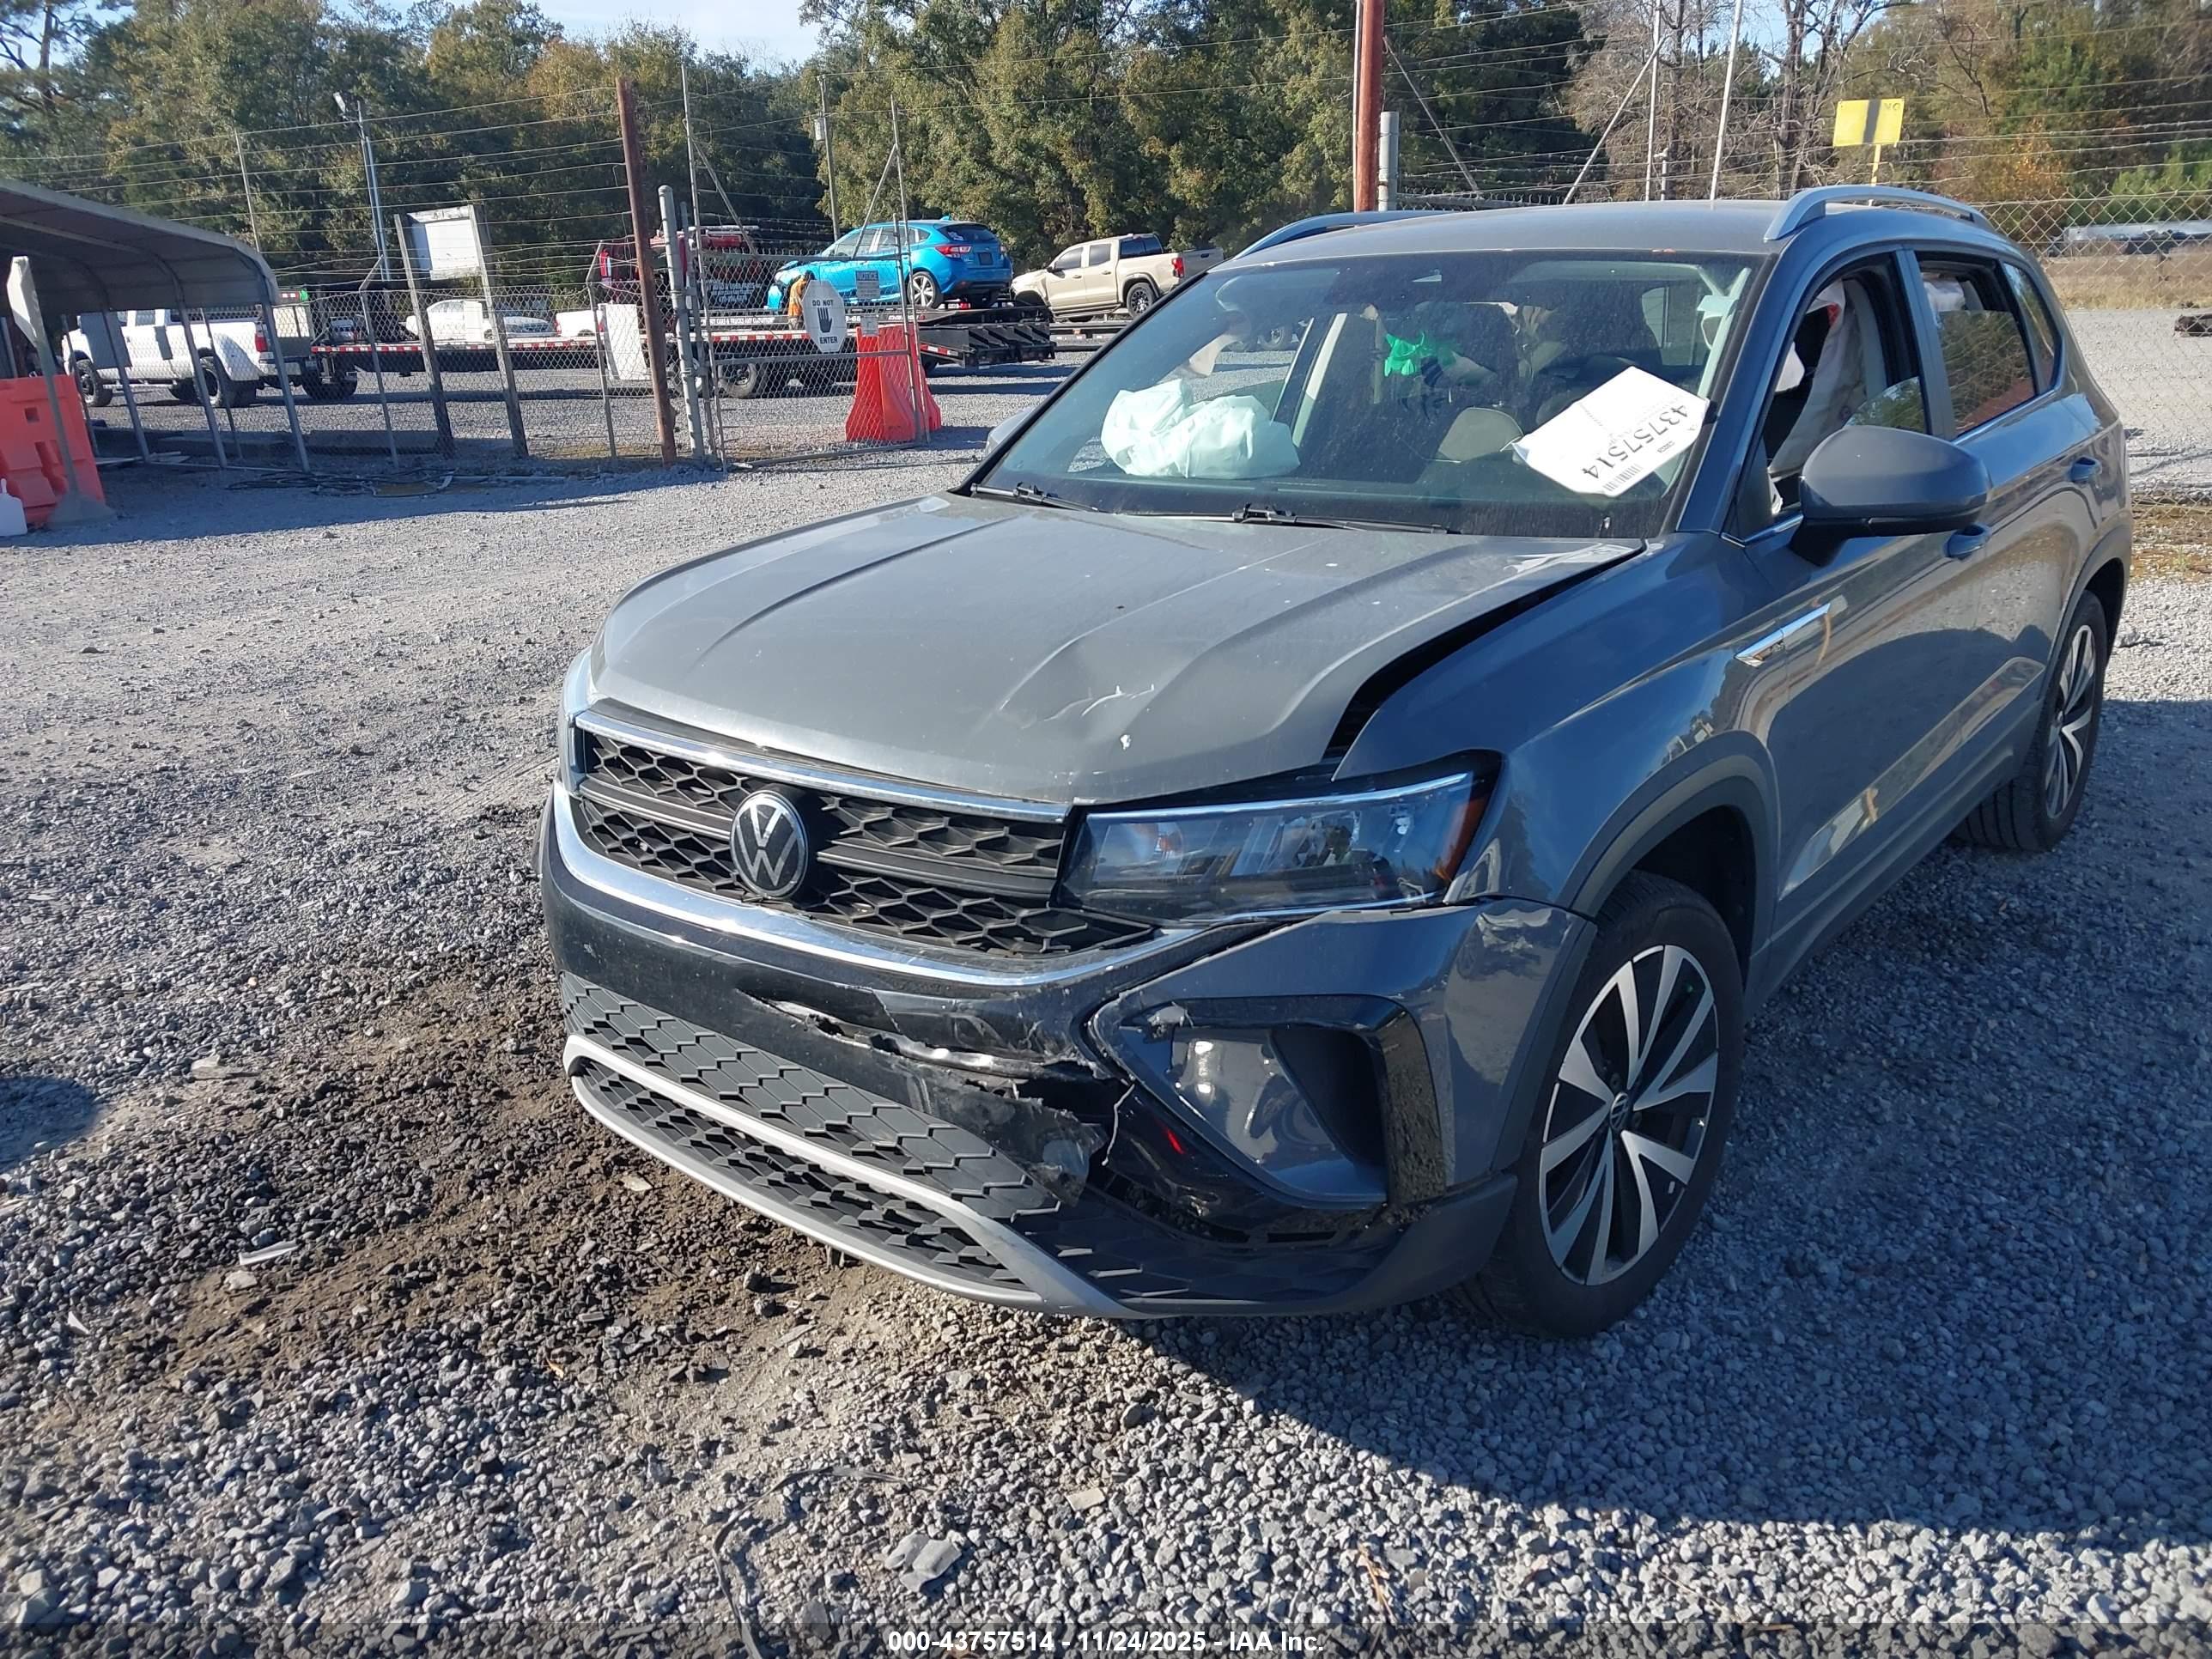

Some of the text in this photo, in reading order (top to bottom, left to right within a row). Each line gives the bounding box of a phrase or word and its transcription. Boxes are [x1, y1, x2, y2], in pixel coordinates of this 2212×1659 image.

[857, 271, 878, 280] NOTICE
[819, 336, 838, 344] ENTER
[1582, 404, 1688, 480] 43757514
